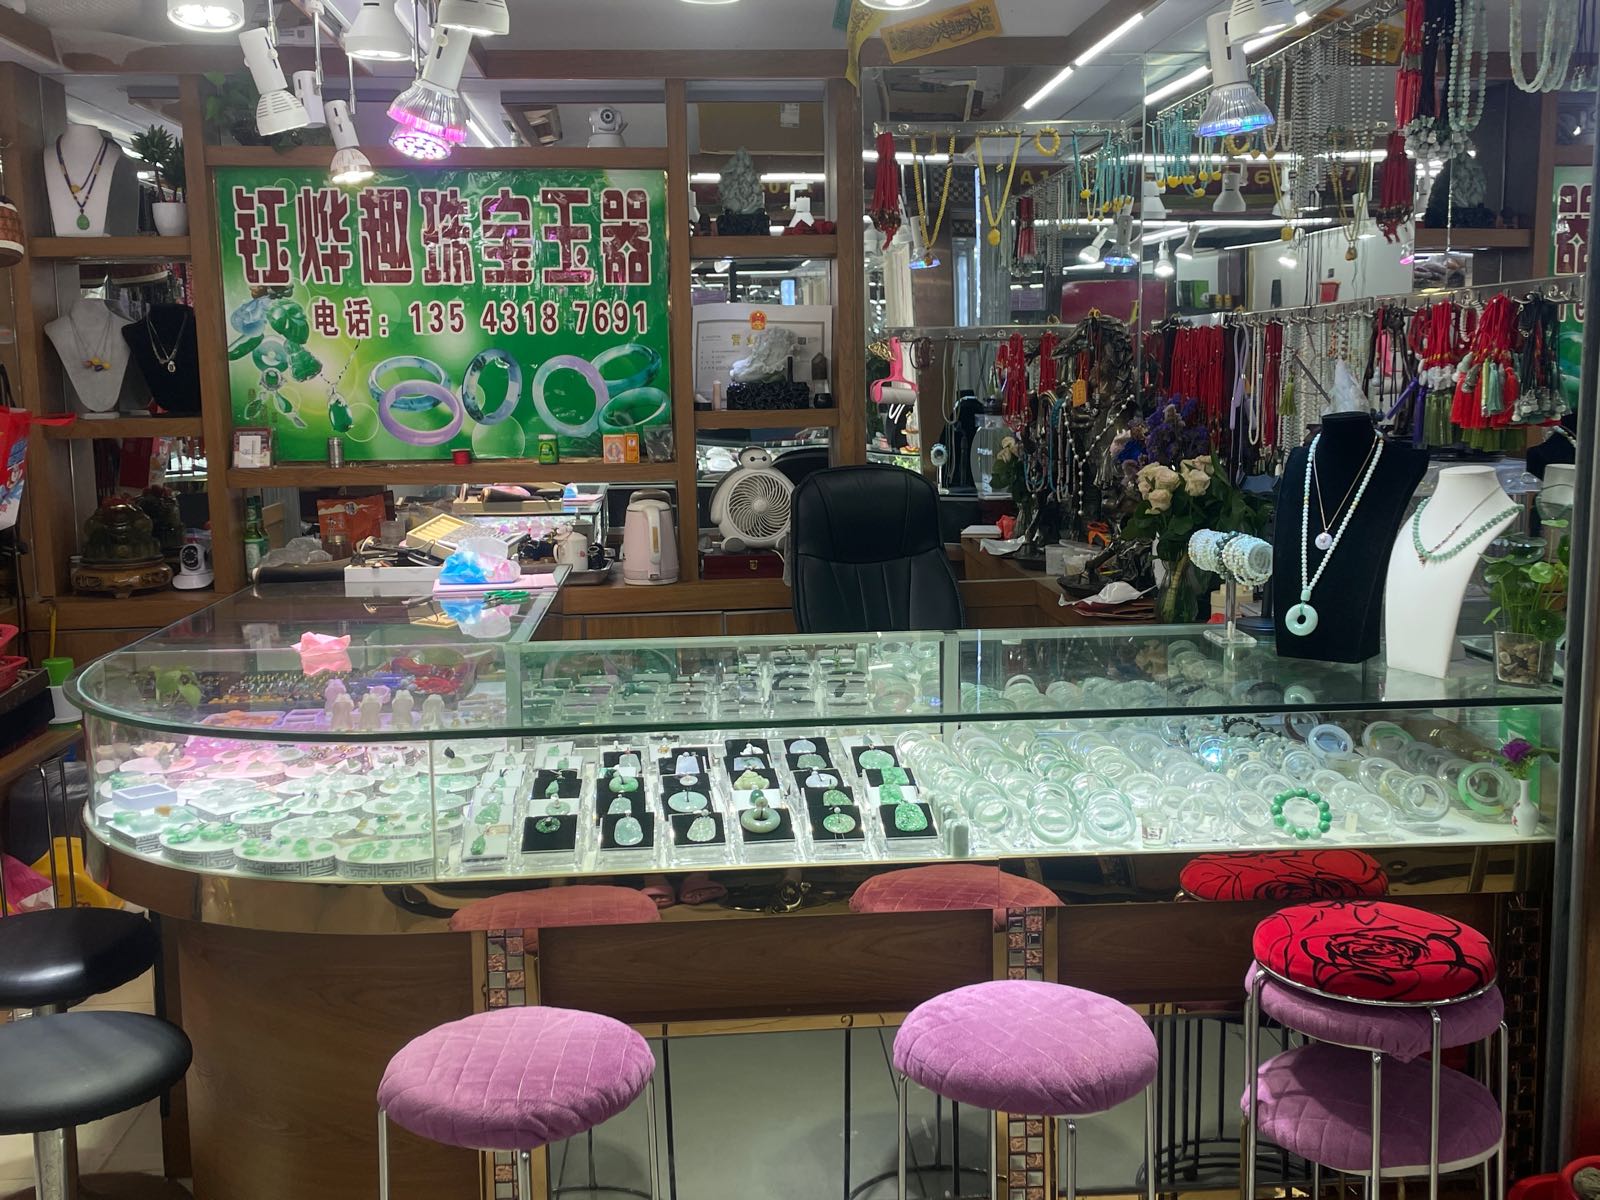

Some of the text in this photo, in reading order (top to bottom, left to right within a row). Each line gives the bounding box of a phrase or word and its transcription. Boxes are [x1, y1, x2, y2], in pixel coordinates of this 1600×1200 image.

[232, 186, 652, 286] 钰烨趣珠宝玉器
[313, 297, 649, 338] 电话： 135 4318 7691
